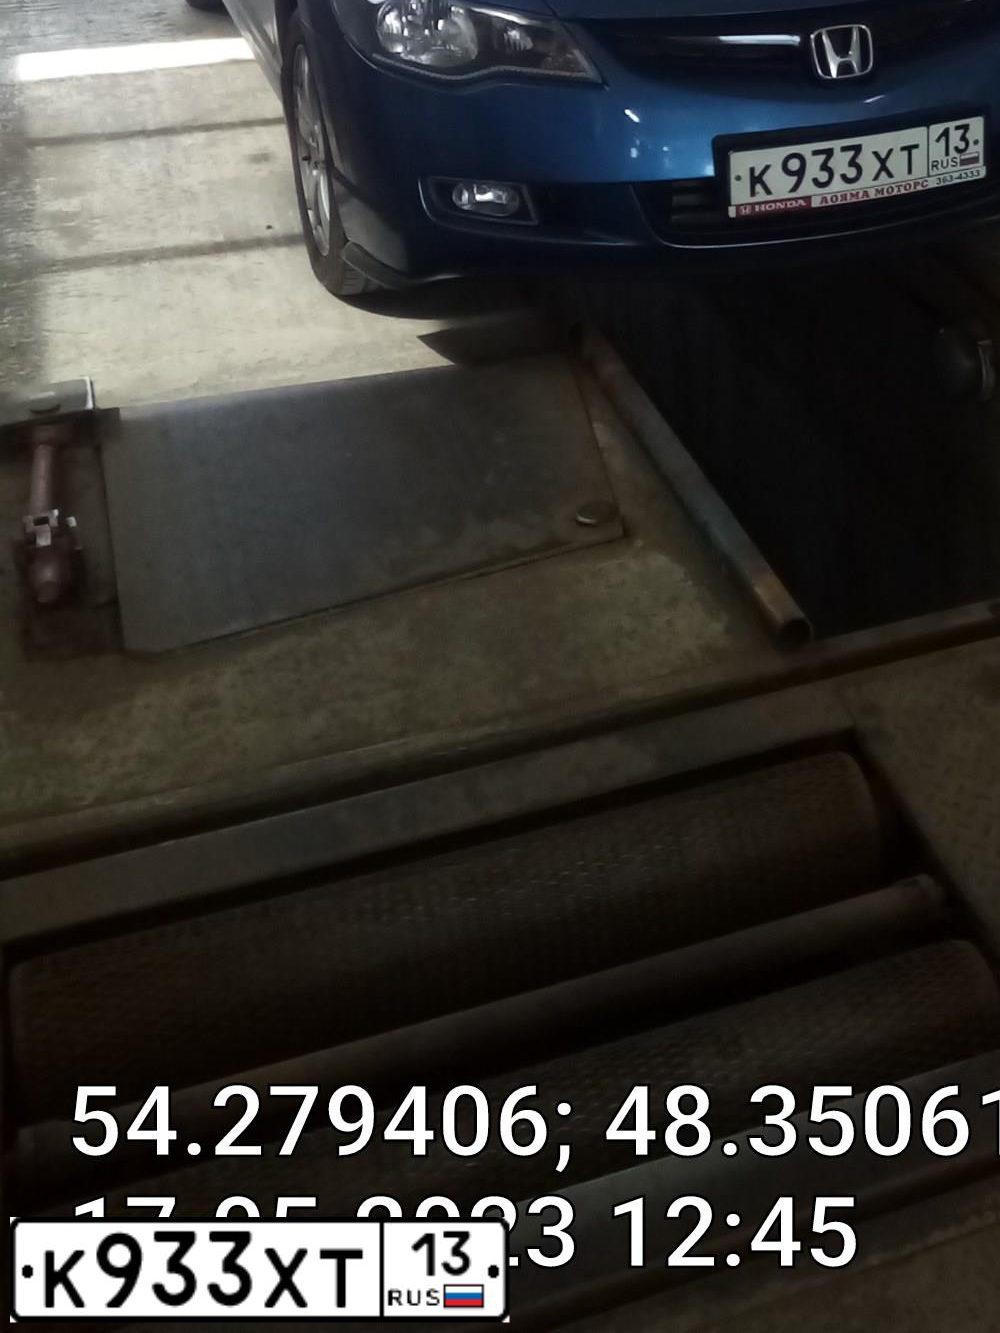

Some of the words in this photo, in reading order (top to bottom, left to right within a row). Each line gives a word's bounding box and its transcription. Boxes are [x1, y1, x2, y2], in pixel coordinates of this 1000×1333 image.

[934, 123, 971, 157] 13
[931, 156, 959, 172] RUS
[754, 198, 807, 213] HONDA
[819, 189, 871, 205] АОЯМА
[874, 179, 929, 198] МОТОРС
